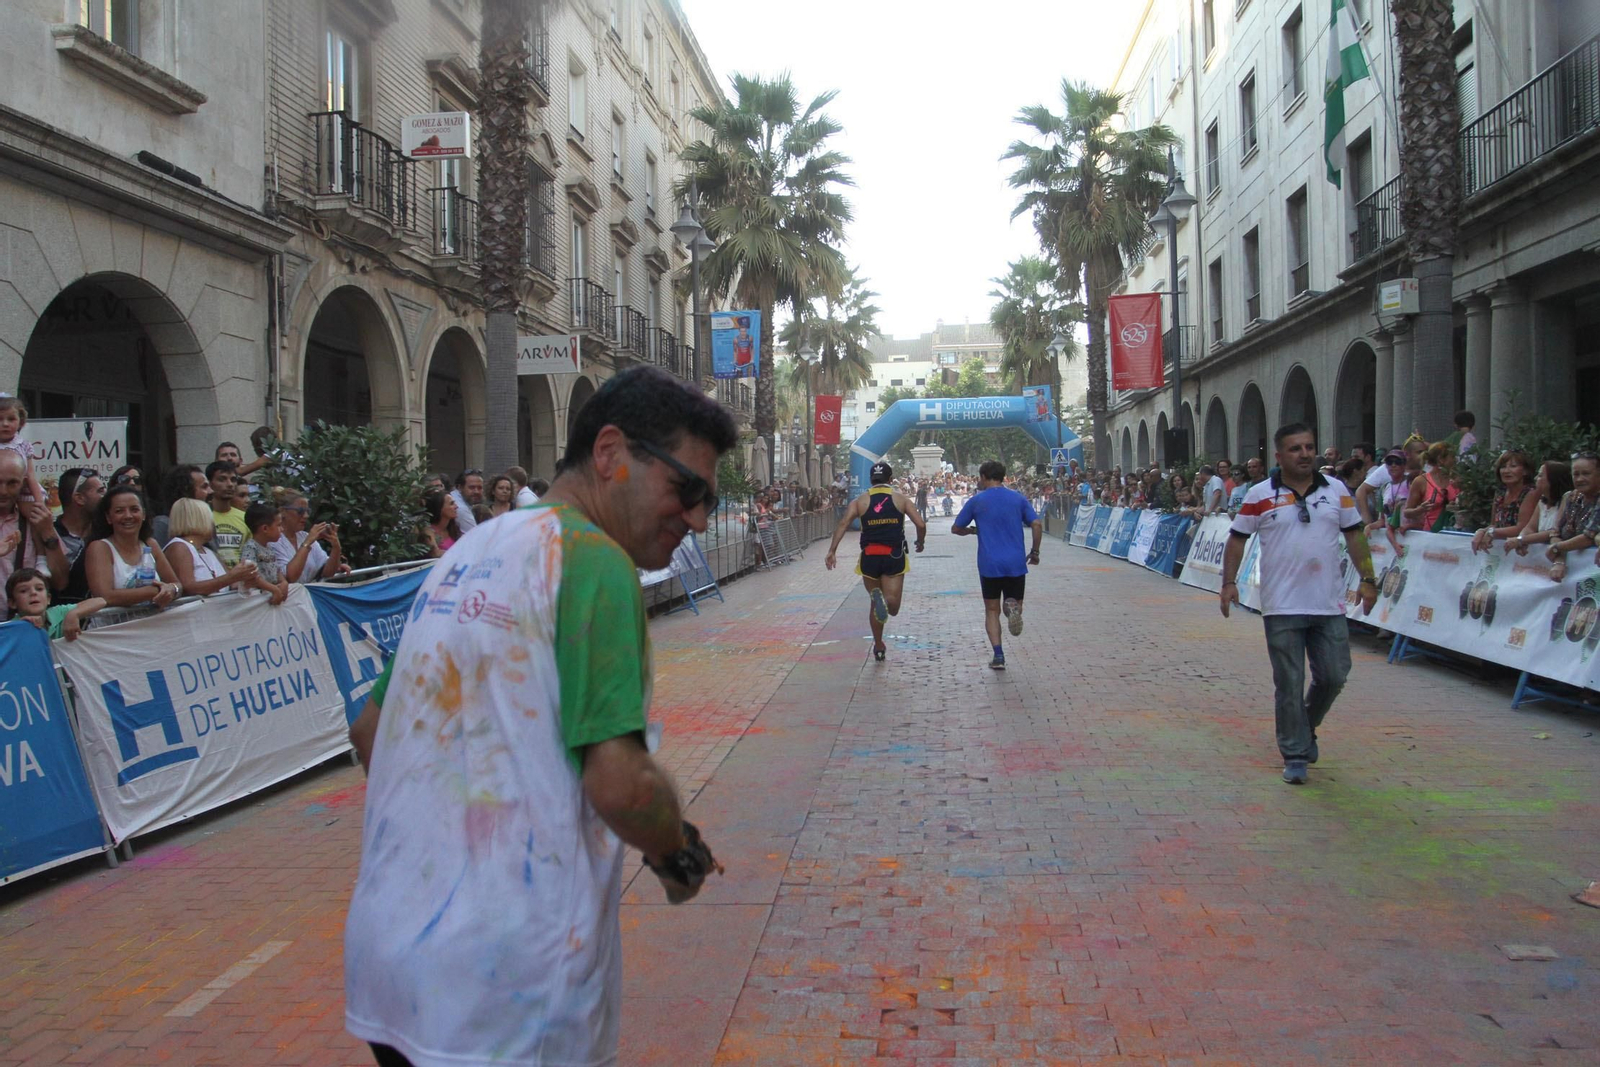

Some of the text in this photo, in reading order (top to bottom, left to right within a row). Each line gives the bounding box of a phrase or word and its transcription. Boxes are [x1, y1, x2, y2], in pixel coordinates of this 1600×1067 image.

[411, 118, 436, 128] GOMEZ
[436, 118, 442, 127] &
[945, 399, 1010, 410] DIPUTACIÓN
[946, 410, 1005, 421] DE HUELVA
[176, 626, 320, 696] DIPUTACIÓN
[189, 668, 320, 738] DE HUELVA
